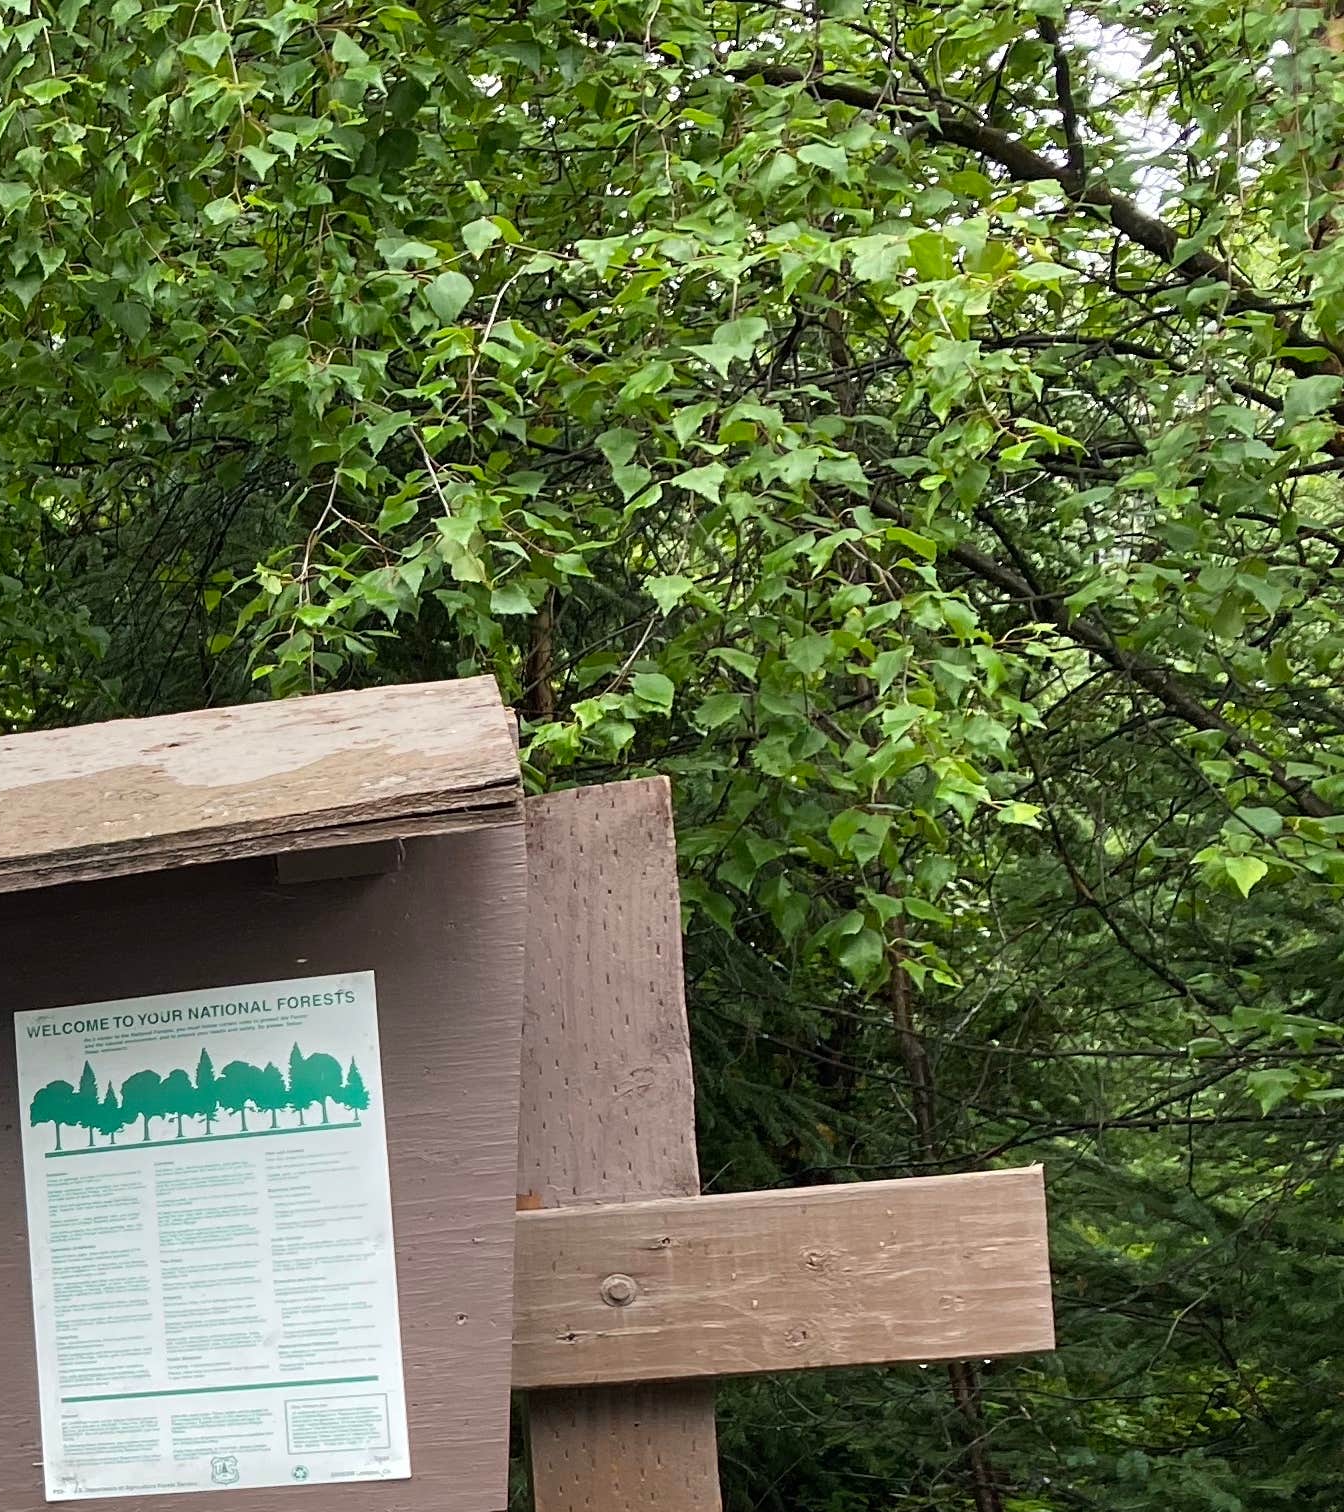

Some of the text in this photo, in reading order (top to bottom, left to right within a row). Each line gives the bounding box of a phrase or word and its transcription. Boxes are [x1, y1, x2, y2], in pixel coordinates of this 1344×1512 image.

[27, 1018, 109, 1039] WELCOME
[112, 1015, 134, 1029] TO
[137, 1010, 183, 1026] YOUR
[188, 999, 273, 1021] NATIONAL
[277, 989, 355, 1011] FORESTS
